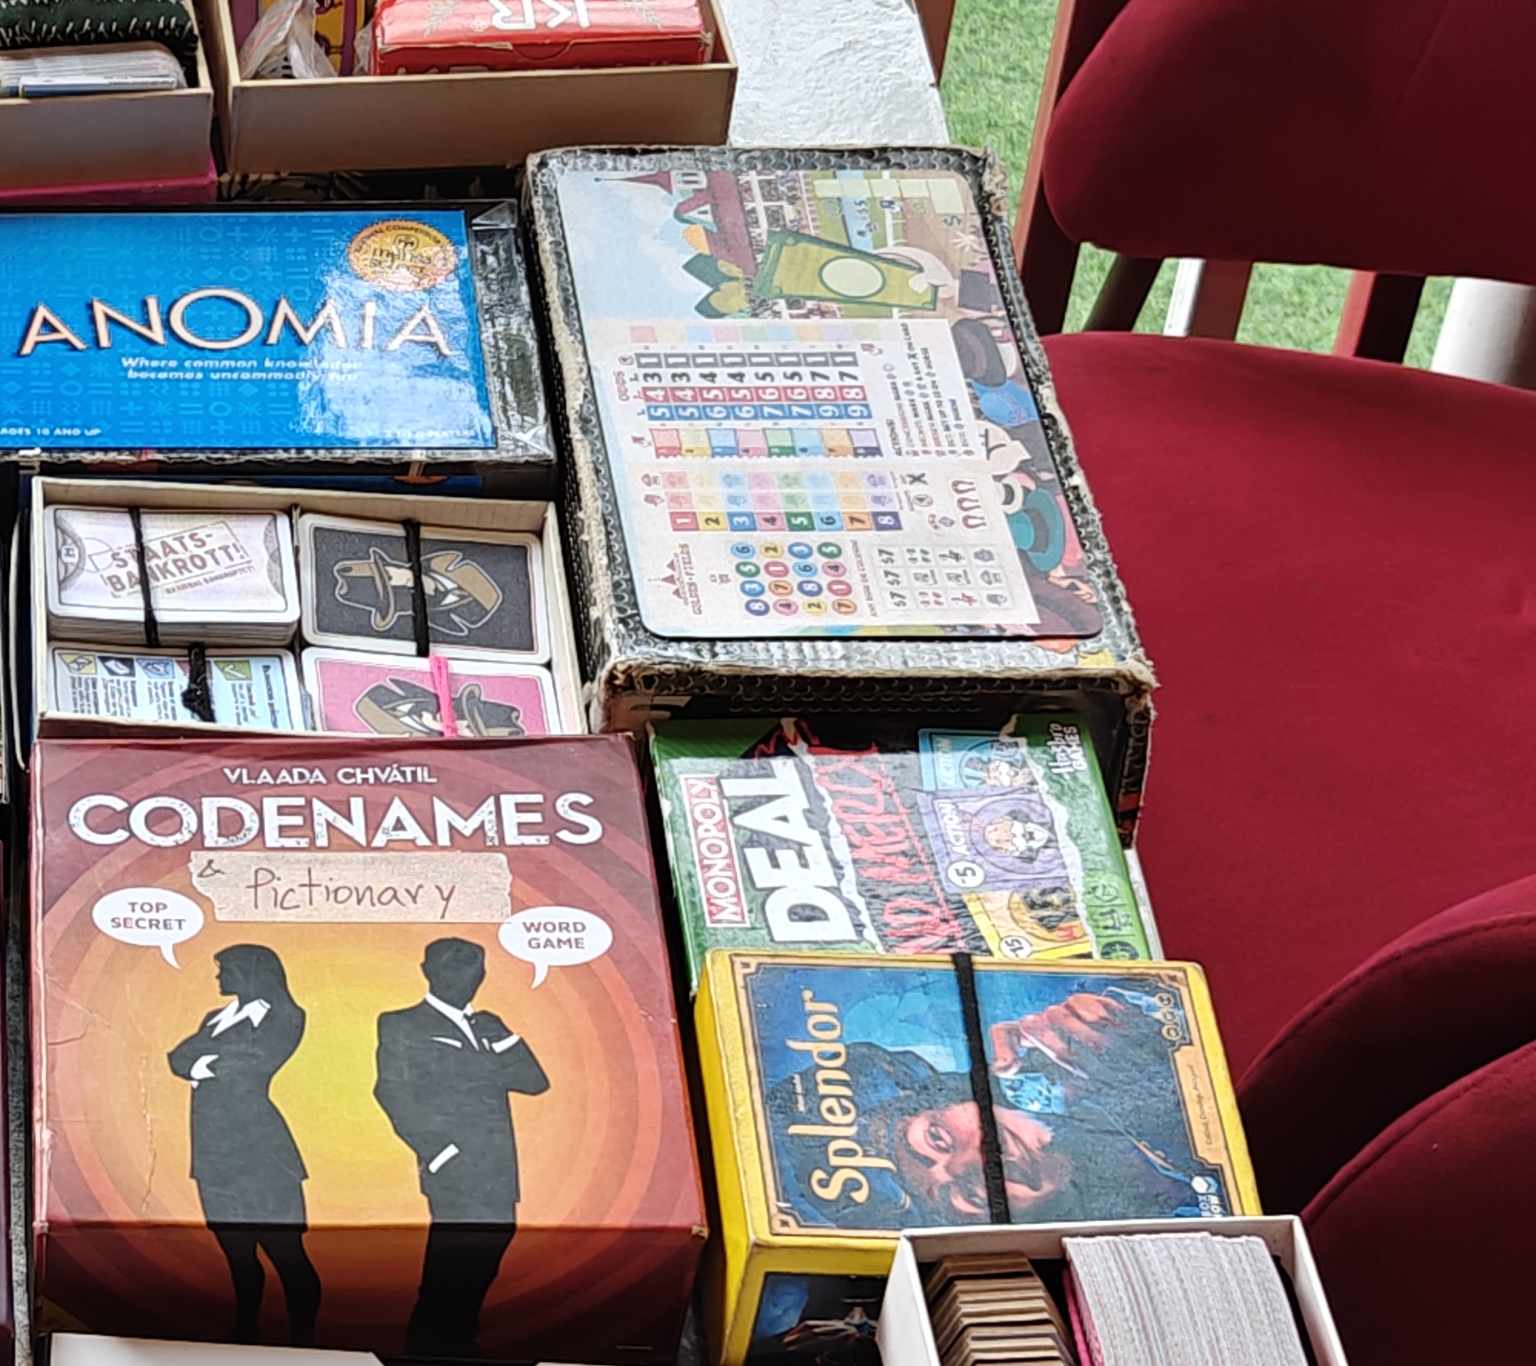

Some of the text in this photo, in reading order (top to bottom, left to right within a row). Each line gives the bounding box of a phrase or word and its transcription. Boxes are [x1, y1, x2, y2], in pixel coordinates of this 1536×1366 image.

[18, 285, 454, 358] ANOMIA
[120, 356, 178, 369] Where
[183, 358, 258, 369] common
[126, 368, 205, 381] becomes
[0, 426, 32, 436] AGES
[223, 762, 438, 786] VLAADA CHVÁTIL
[1048, 723, 1076, 776] Hasbro
[67, 791, 604, 849] CODENAMES
[938, 802, 971, 857] ACTION
[686, 777, 745, 926] MONOPOLY
[718, 759, 865, 943] DEAL
[126, 901, 169, 915] TOP
[245, 866, 458, 920] Pictionary
[110, 915, 187, 933] SECRET
[521, 920, 587, 936] WORD
[526, 936, 586, 951] GAME
[882, 897, 963, 955] NO
[787, 988, 898, 1205] Splendor
